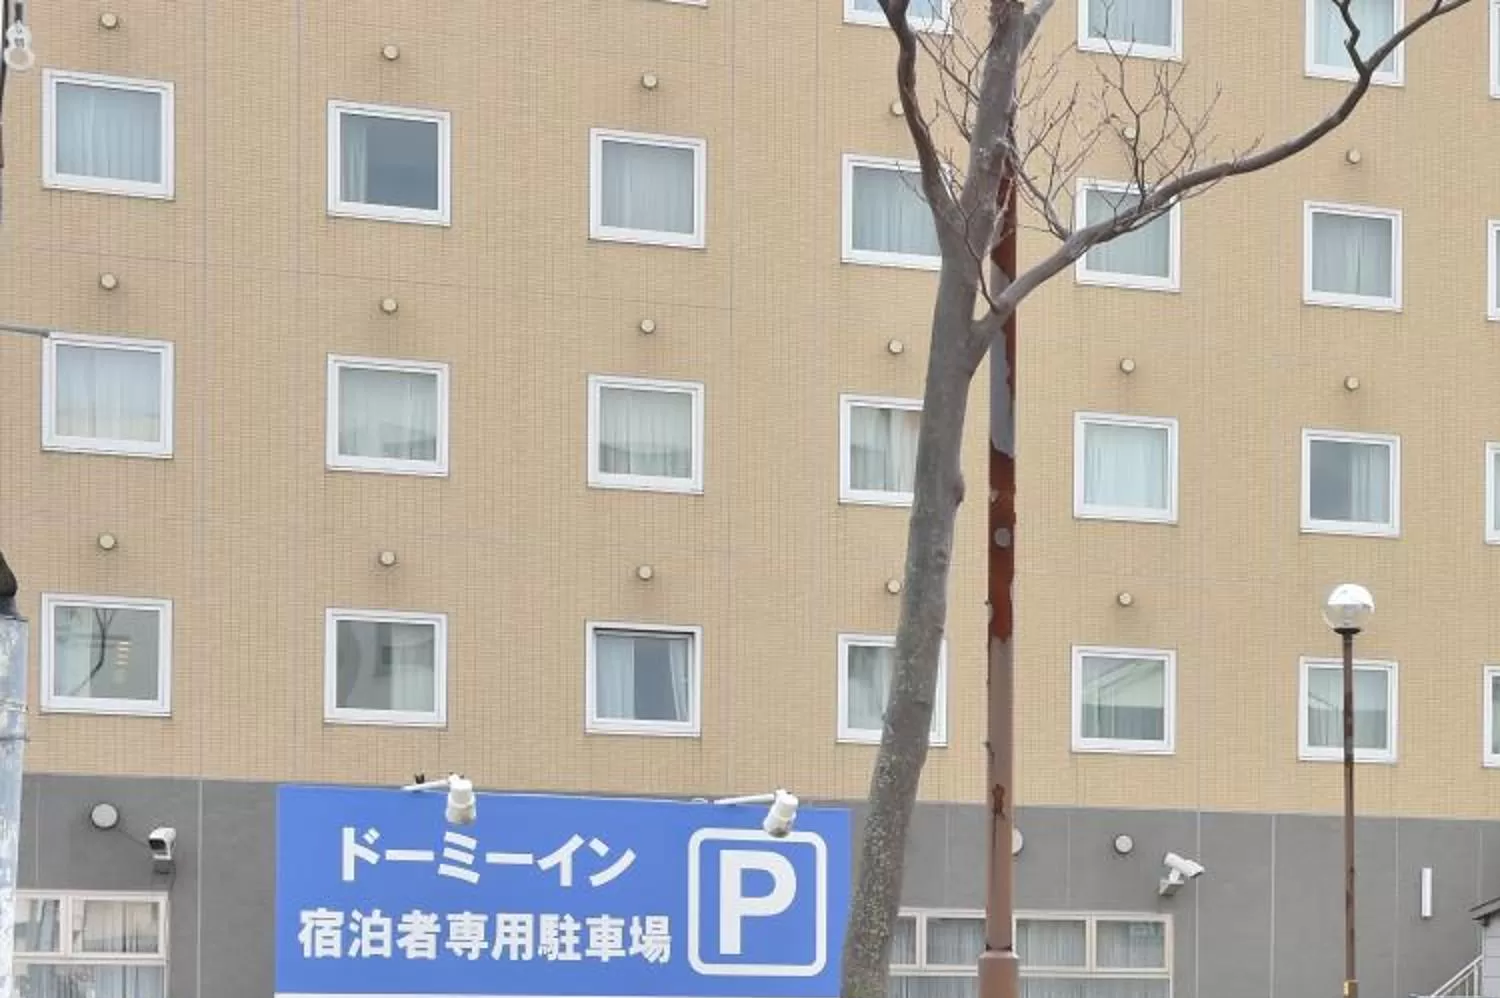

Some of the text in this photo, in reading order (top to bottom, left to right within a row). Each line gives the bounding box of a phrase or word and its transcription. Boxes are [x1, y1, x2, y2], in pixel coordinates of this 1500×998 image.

[341, 826, 637, 888] ドーミーイン
[719, 849, 797, 955] P
[298, 907, 673, 965] 宿泊者専用駐車場
